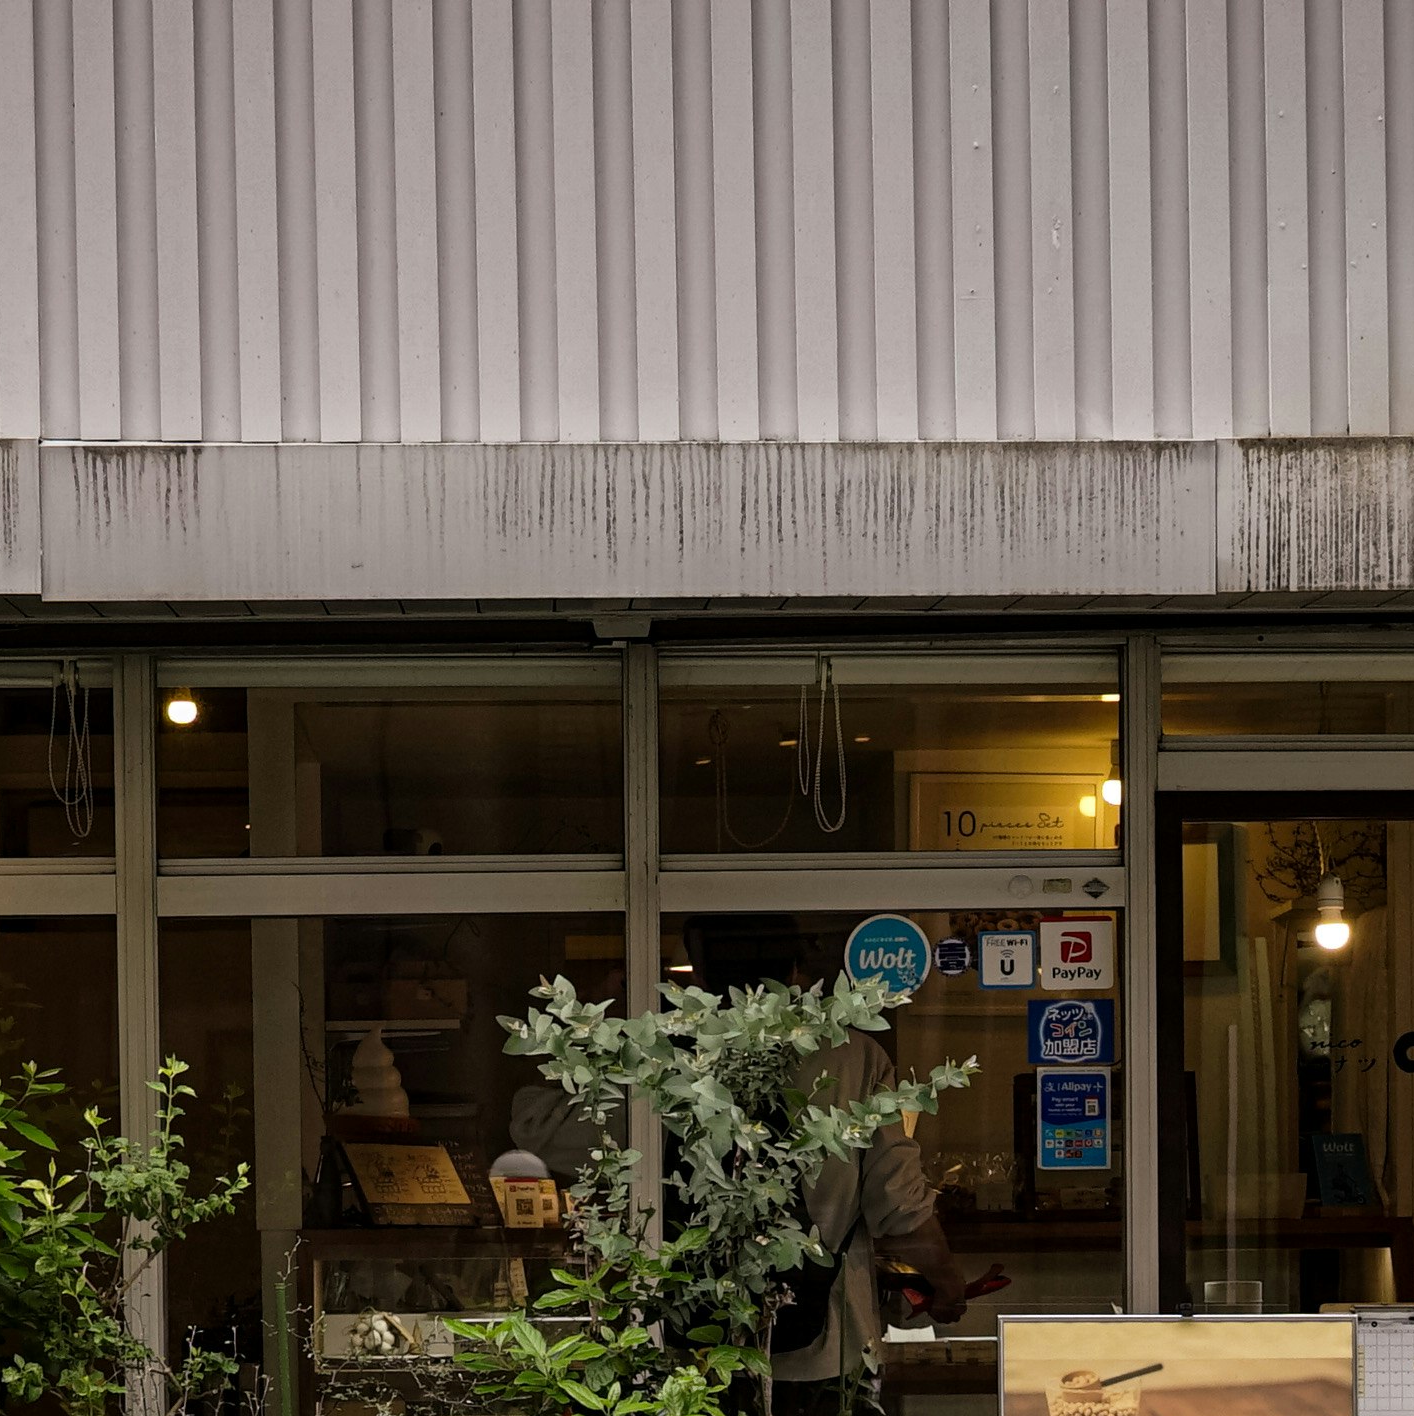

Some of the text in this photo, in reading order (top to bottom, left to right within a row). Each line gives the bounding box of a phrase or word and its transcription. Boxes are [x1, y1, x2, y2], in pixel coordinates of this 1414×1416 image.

[943, 810, 976, 837] 10
[1037, 812, 1065, 829] Set
[986, 936, 1005, 946] FREE
[859, 947, 917, 970] Wolt
[1052, 966, 1102, 981] PayPay
[1050, 1020, 1093, 1038] コイン
[1044, 1038, 1097, 1055] 加盟店
